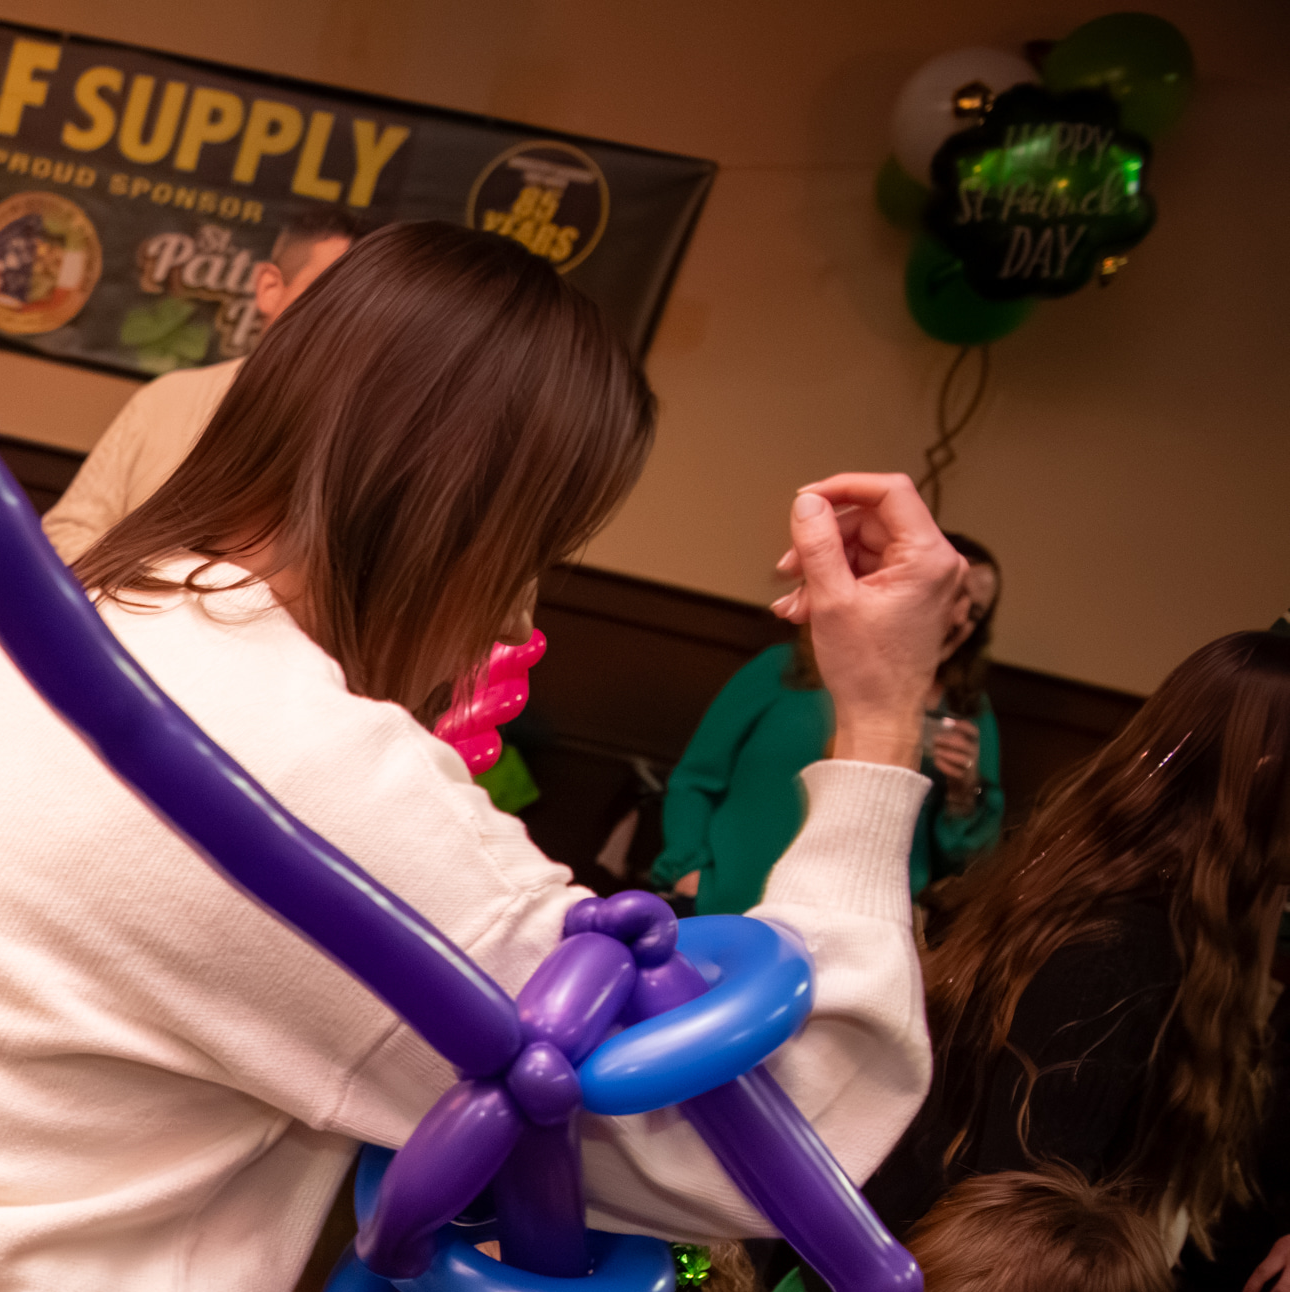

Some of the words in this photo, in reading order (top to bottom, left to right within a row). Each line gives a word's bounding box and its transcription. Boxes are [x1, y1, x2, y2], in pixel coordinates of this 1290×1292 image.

[62, 65, 411, 208] SUPPLY
[108, 172, 264, 224] SPONSOR
[995, 225, 1089, 280] DAY
